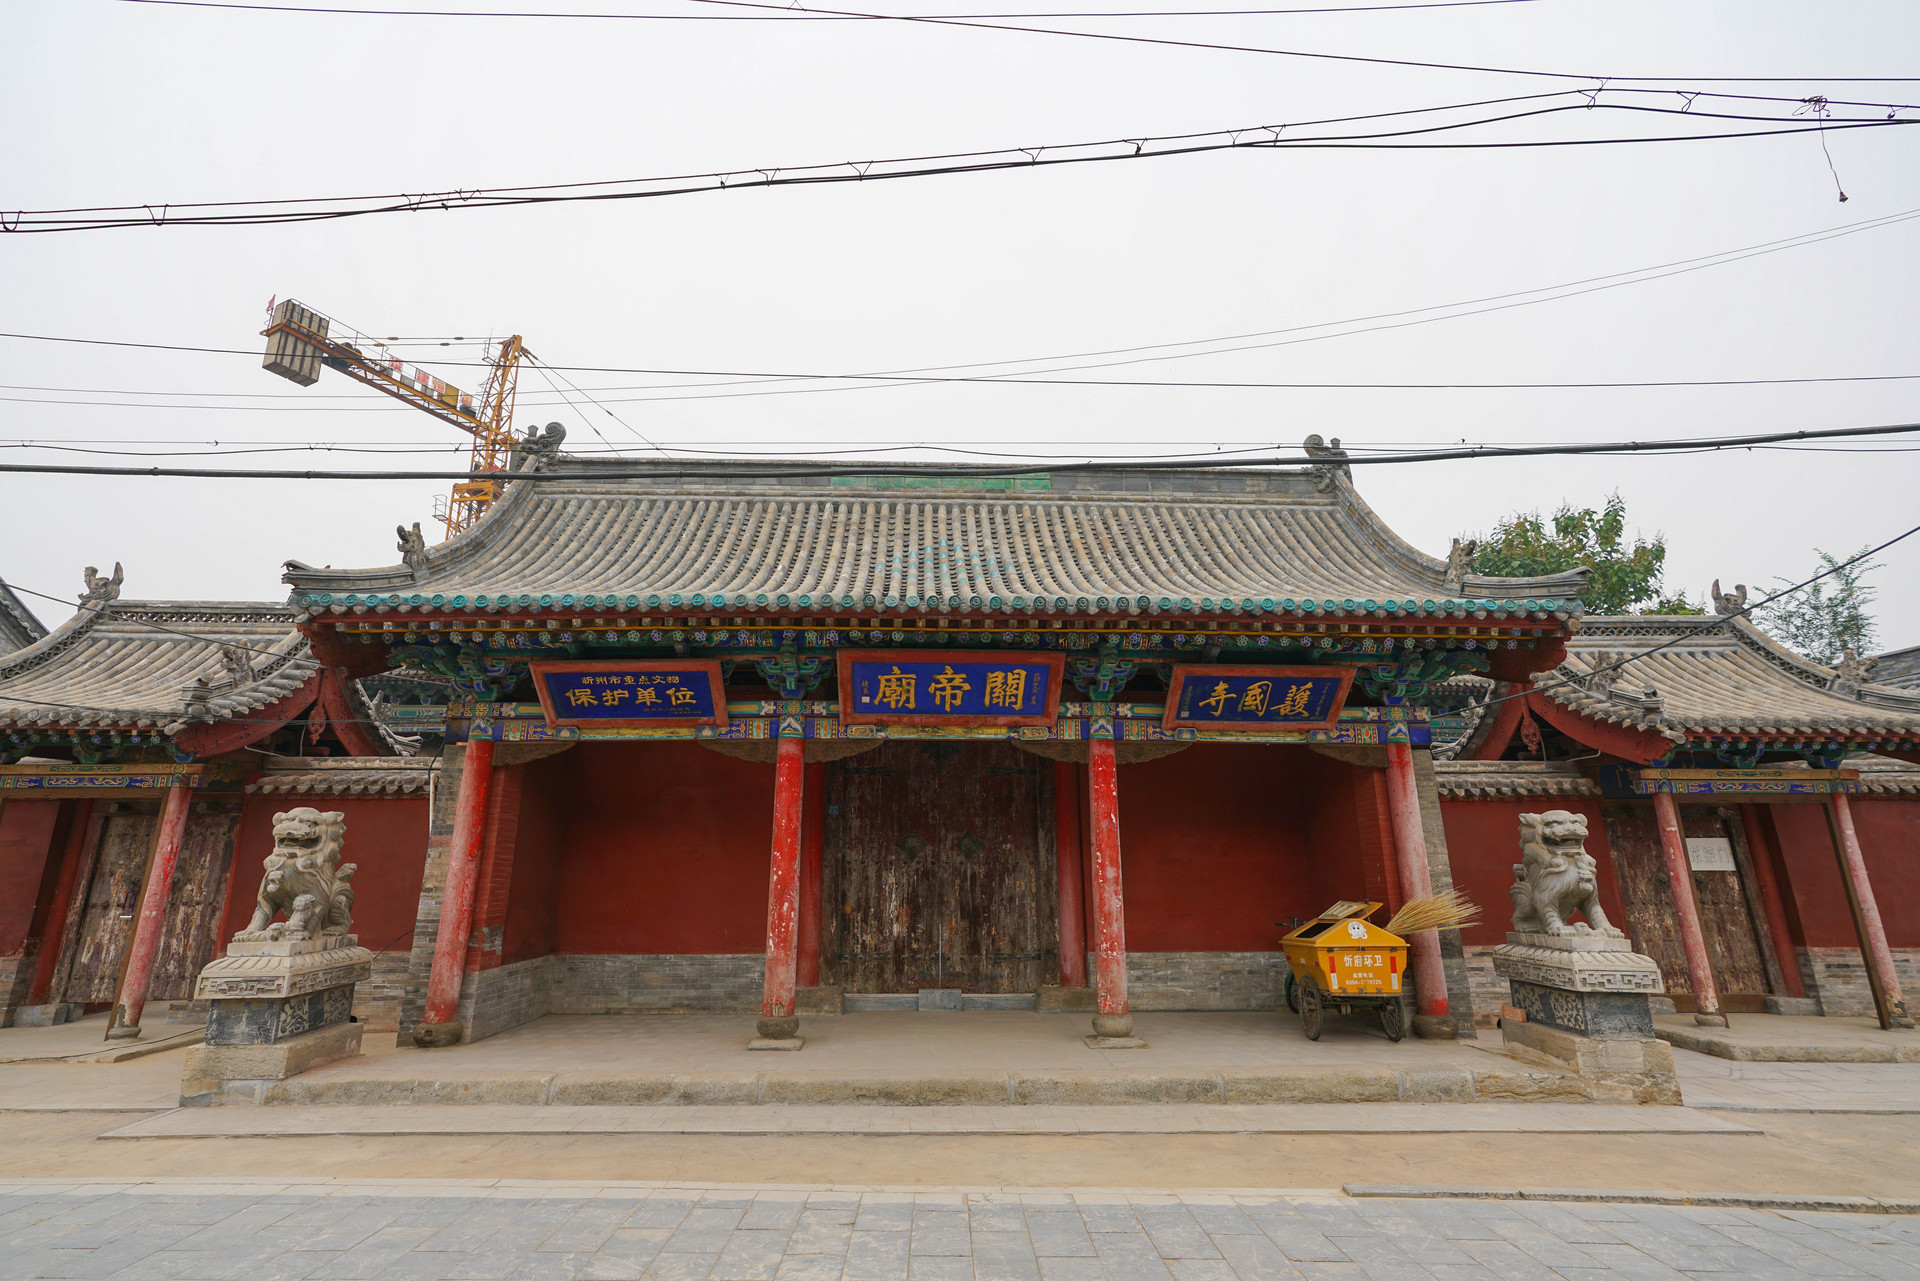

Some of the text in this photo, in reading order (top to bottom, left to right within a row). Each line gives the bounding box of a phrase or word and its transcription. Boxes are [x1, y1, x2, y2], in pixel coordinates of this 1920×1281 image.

[581, 675, 680, 685] 忻州市重点文物
[873, 665, 1027, 712] 關帝廟
[565, 687, 697, 707] 保护单位
[1199, 680, 1313, 717] 護國寺
[1343, 954, 1383, 967] 忻府环卫
